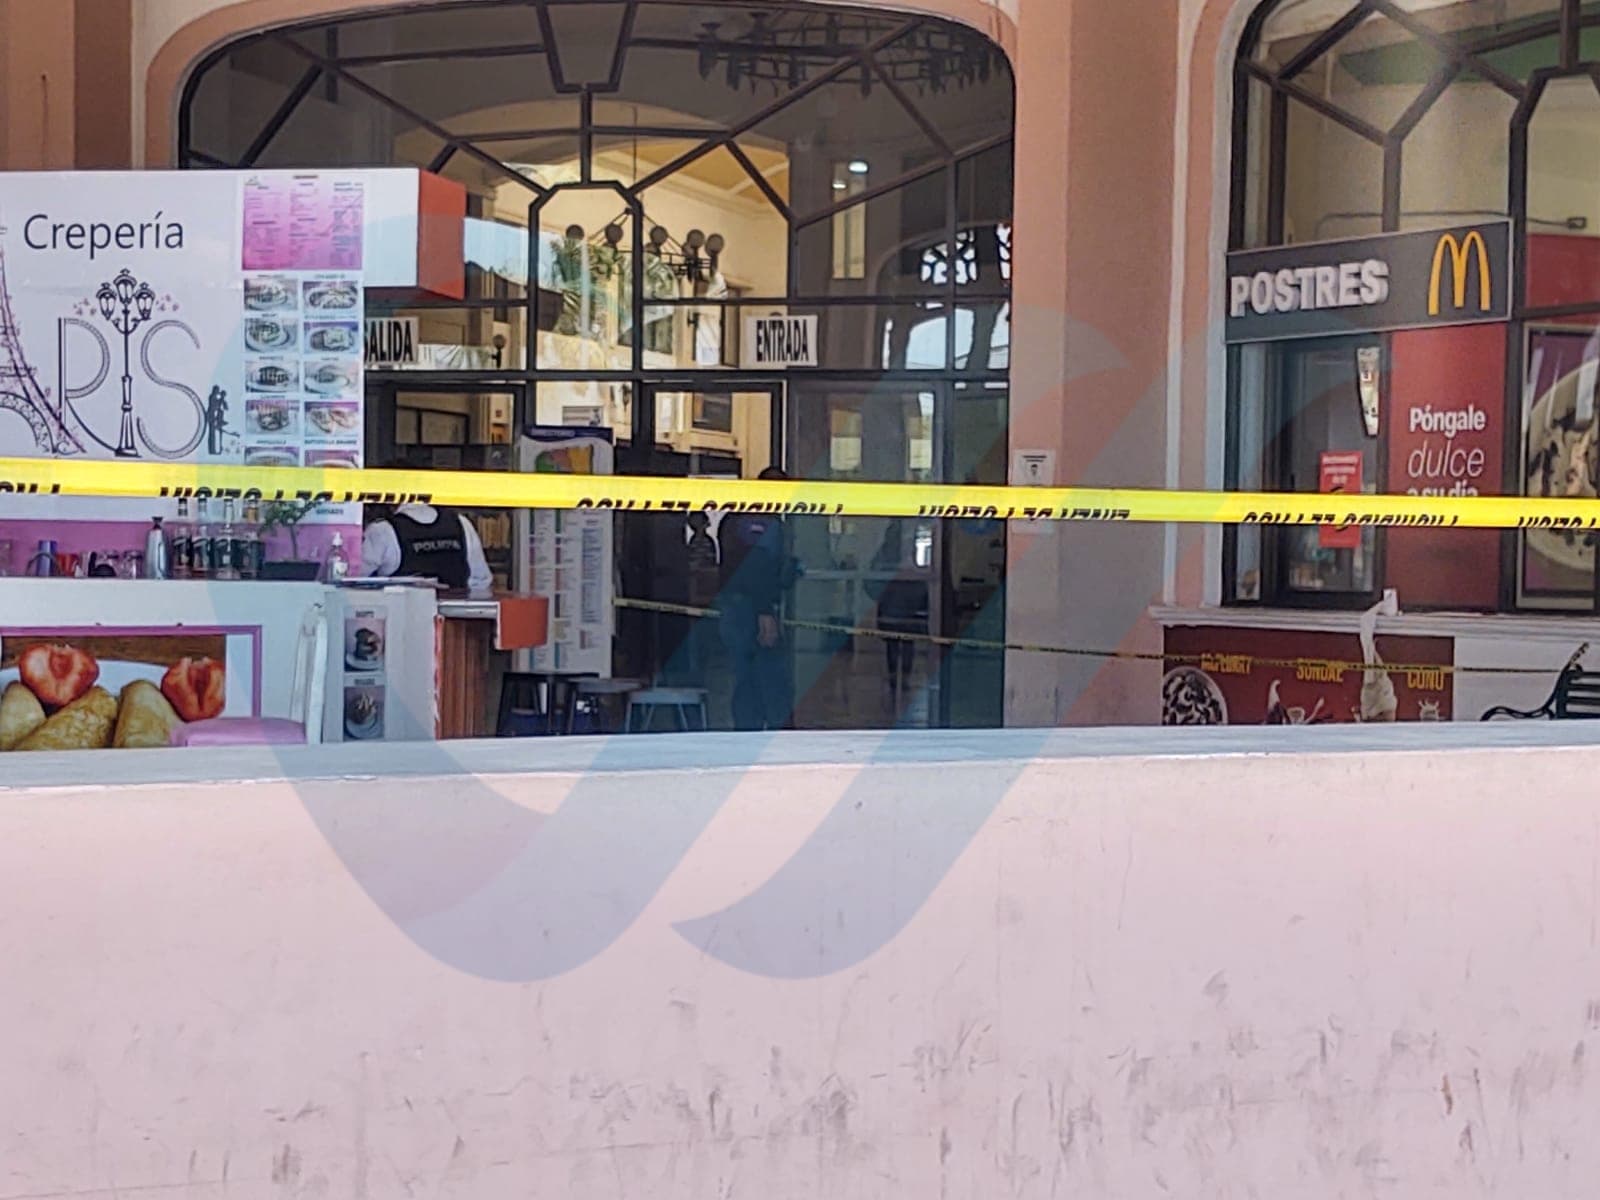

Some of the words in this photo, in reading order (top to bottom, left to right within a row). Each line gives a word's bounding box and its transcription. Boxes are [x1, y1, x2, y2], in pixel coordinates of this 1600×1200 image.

[24, 211, 184, 260] Crepería
[1230, 259, 1390, 317] POSTRES
[757, 319, 809, 362] ENTRADA
[1409, 403, 1486, 438] Póngale
[1407, 440, 1485, 478] dulce
